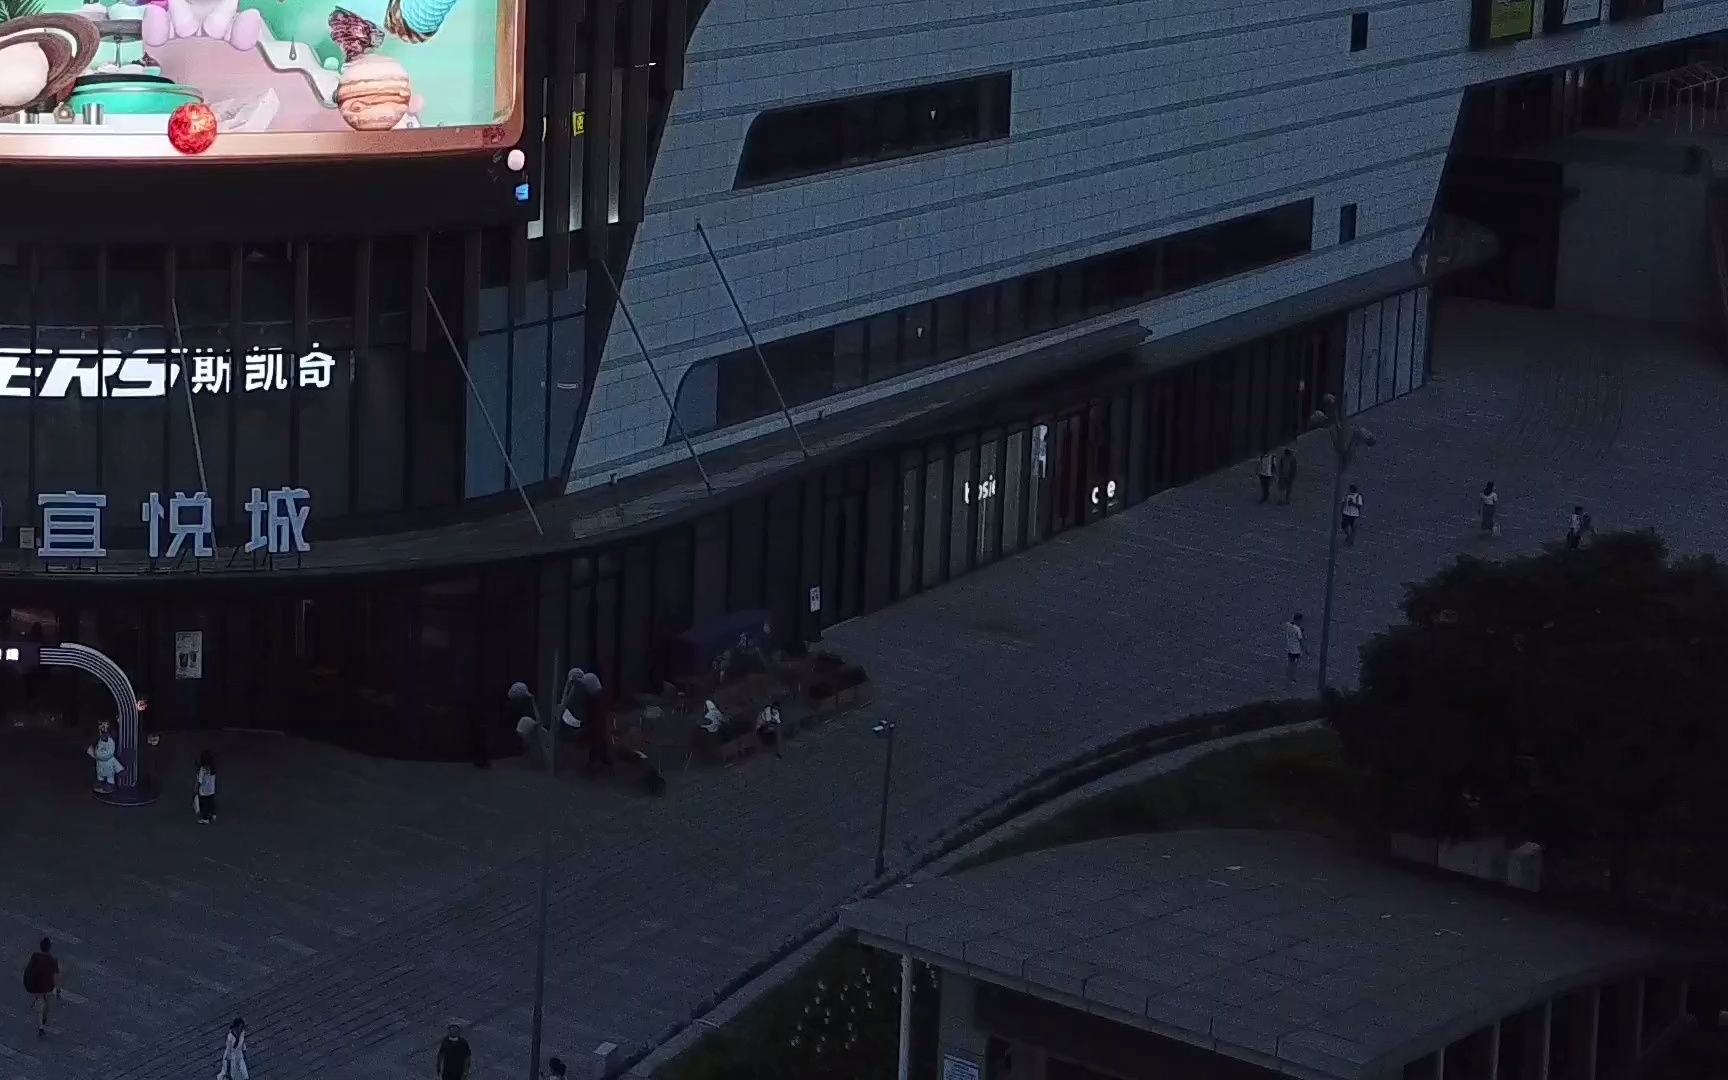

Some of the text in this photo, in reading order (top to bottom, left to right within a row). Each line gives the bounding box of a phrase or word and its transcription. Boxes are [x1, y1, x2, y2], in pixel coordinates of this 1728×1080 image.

[191, 342, 336, 395] 斯凯奇
[37, 486, 311, 558] 宜悦城
